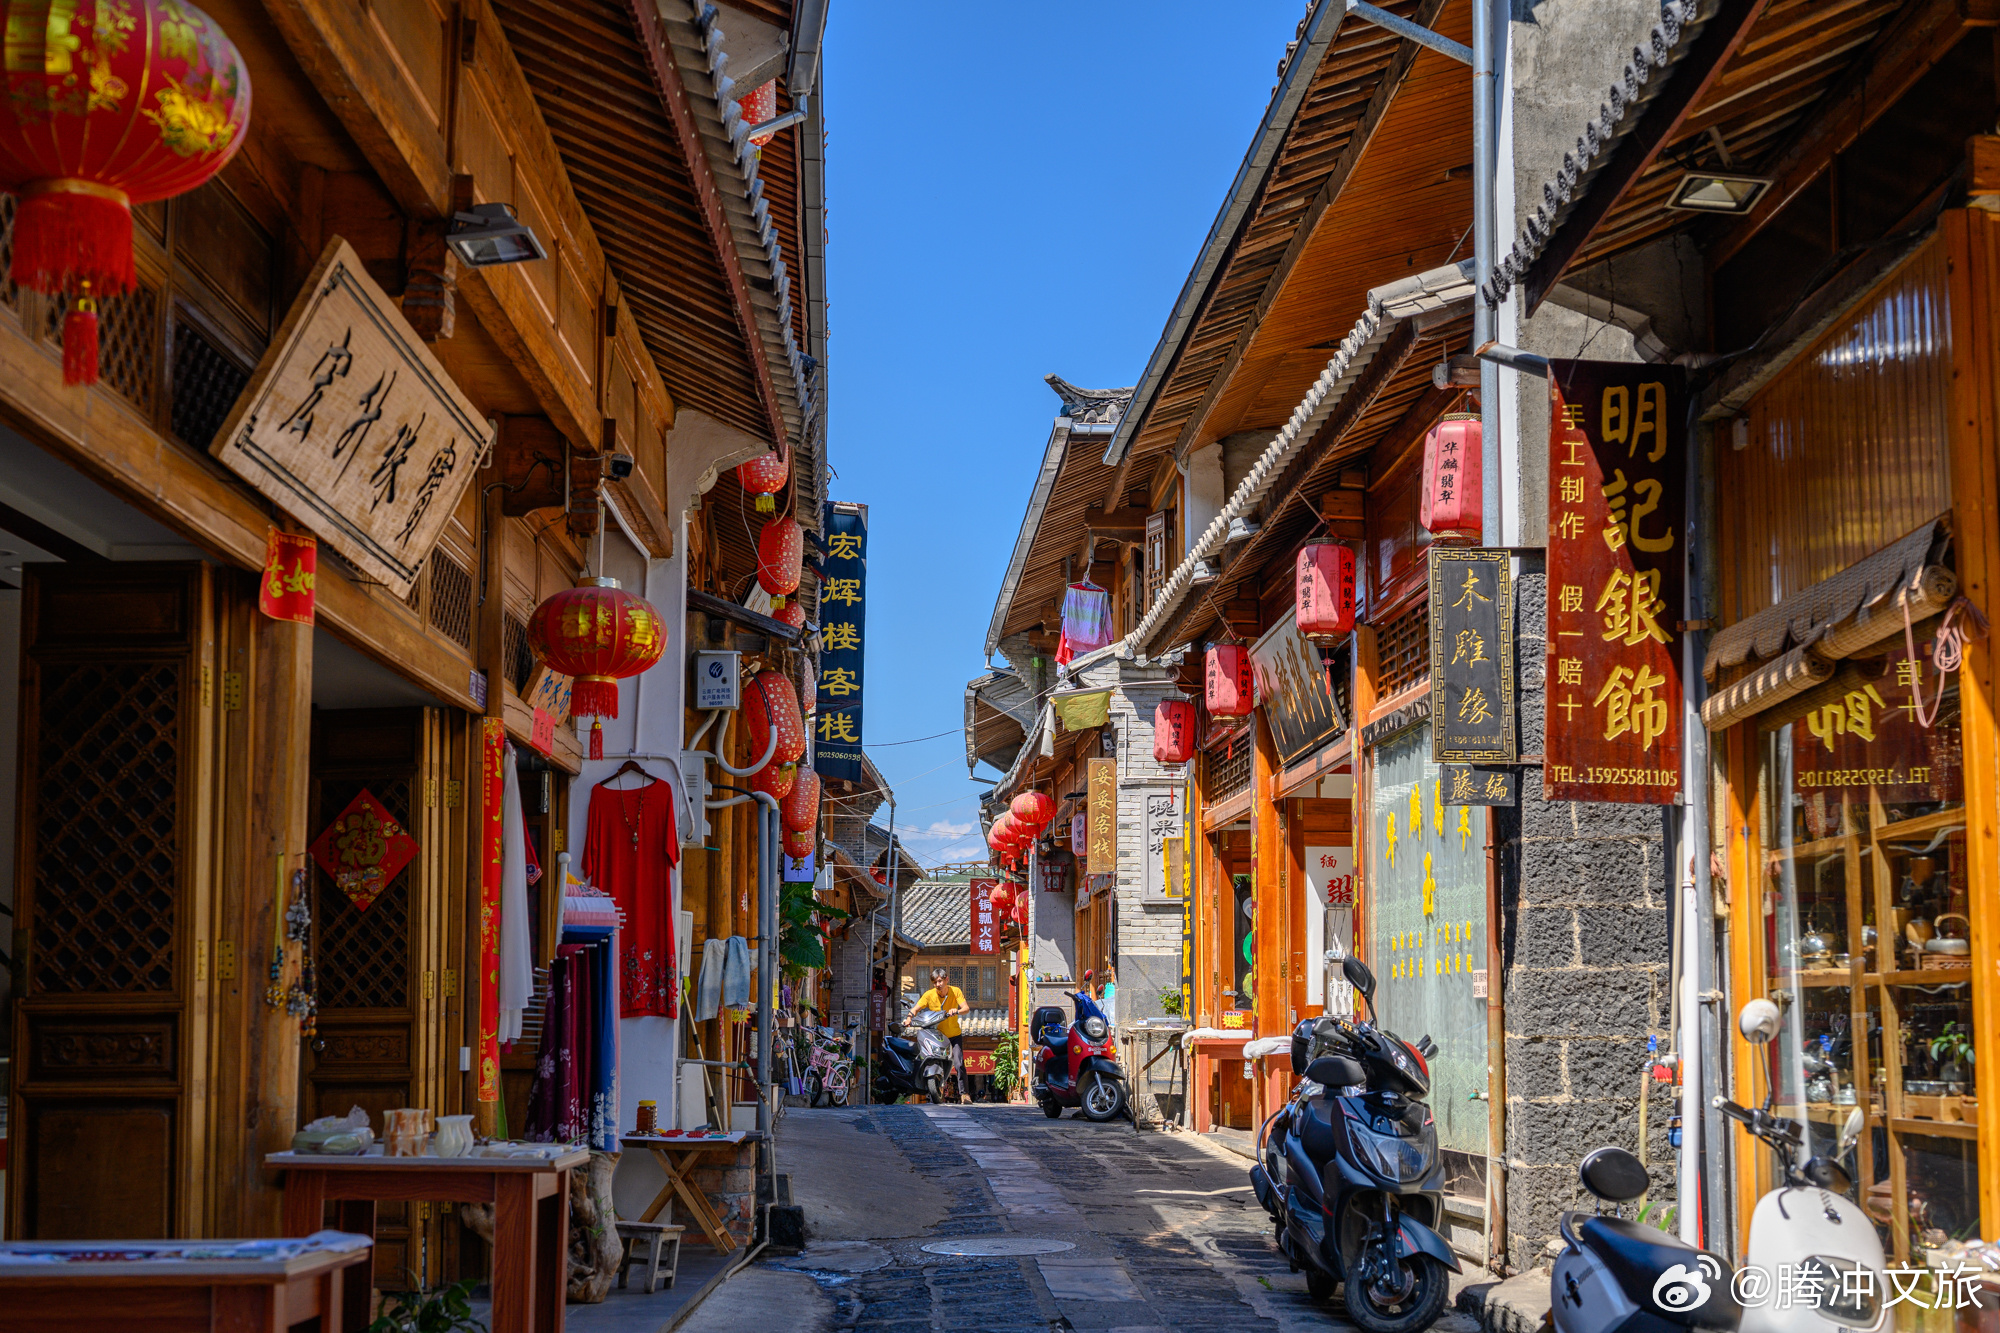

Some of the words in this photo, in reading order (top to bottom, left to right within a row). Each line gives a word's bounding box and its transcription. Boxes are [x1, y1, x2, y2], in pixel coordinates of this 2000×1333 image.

[1559, 404, 1585, 540] 手工制作
[1593, 380, 1674, 752] 明記銀飾
[817, 531, 863, 743] 宏辉楼客栈
[1558, 584, 1584, 722] 假一赔十
[817, 750, 862, 762] 15025060598
[1092, 765, 1113, 859] 妥妥客栈
[337, 811, 387, 866] 福
[978, 898, 993, 952] 铜瓢火锅
